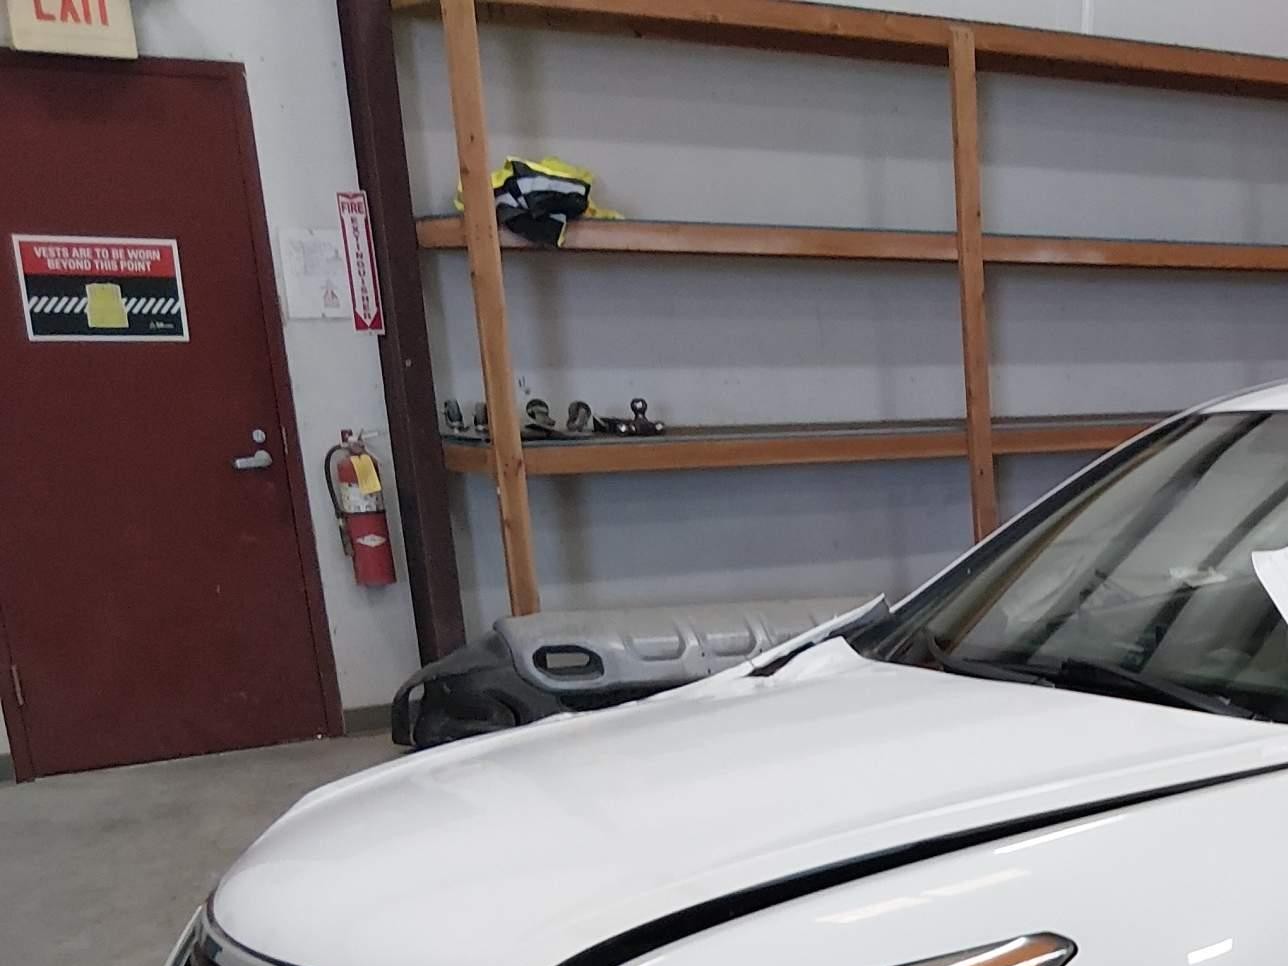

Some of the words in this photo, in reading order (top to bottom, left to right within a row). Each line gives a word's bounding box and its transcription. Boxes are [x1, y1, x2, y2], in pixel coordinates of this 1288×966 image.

[340, 201, 365, 214] FIRE
[33, 246, 70, 259] VESTS
[72, 247, 93, 260] ARE
[96, 248, 109, 260] TO
[112, 248, 125, 260] BE
[128, 248, 161, 262] WORN
[47, 257, 92, 271] BEYOND
[94, 259, 118, 272] THIS
[120, 259, 152, 272] POINT
